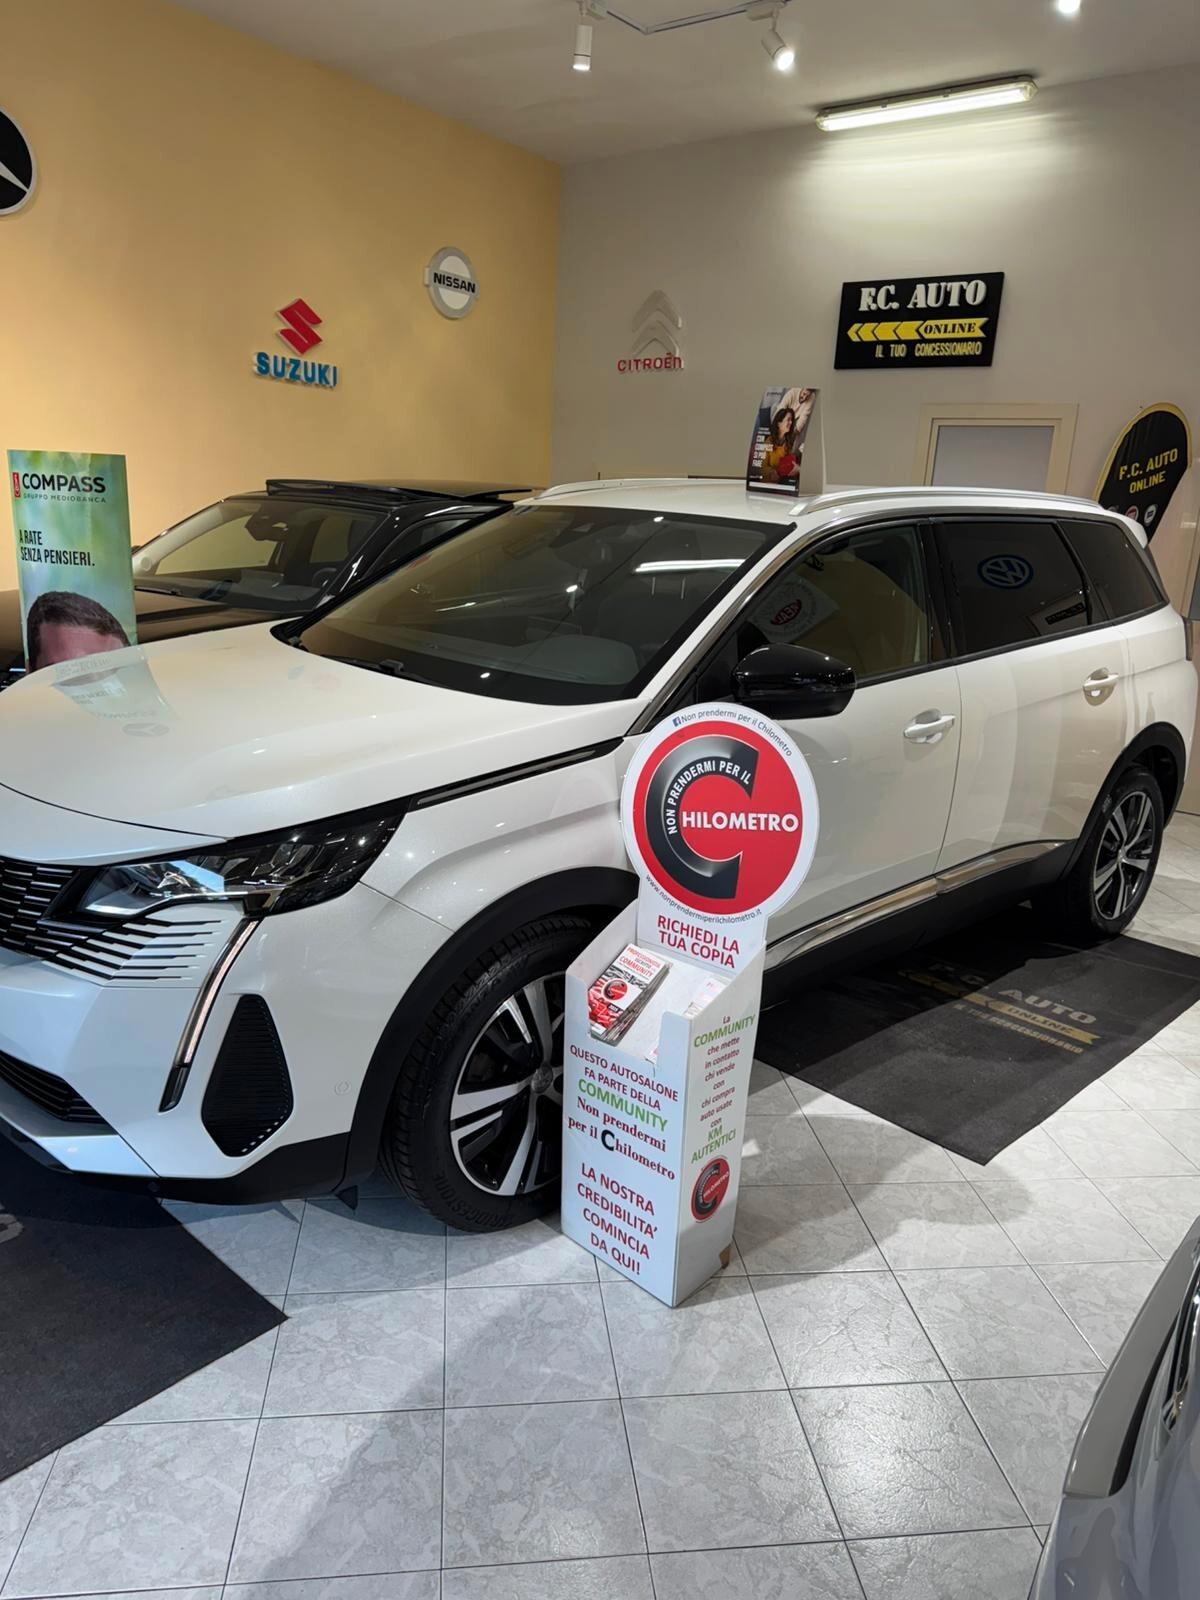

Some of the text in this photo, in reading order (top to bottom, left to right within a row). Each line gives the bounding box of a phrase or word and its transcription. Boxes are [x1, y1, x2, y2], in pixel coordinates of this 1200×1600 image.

[433, 272, 476, 294] NISSAN
[906, 279, 987, 309] AUTO
[923, 322, 977, 335] ONLINE
[875, 341, 983, 358] IL TUO CONCESSIONARIO
[256, 352, 337, 387] SUZUKI
[1119, 448, 1178, 480] F.C. AUTO
[22, 473, 106, 494] COMPASS
[1129, 470, 1166, 494] ONLINE
[51, 495, 106, 503] MEDIOBANCA
[19, 529, 43, 546] A RATE
[20, 546, 96, 567] SENZA PENSIERI.
[681, 708, 792, 757] Non prendermi per il Chilometro
[666, 760, 751, 835] NON PRENDERMI PER IL
[657, 914, 740, 955] RICHIEDI LA
[659, 930, 735, 968] TUA COPIA
[619, 955, 653, 977] COMMUNITY
[723, 1015, 731, 1024] La
[998, 989, 1097, 1024] AUTO
[1006, 1006, 1076, 1034] ONLINE
[694, 1014, 756, 1048] COMMUNITY
[704, 1049, 740, 1069] in contatto
[707, 1037, 740, 1055] che mette
[570, 1044, 679, 1102] QUESTO AUTOSALONE
[705, 1062, 735, 1081] chi vende
[713, 1080, 725, 1090] con
[584, 1067, 661, 1111] FA PARTE DELLA
[701, 1086, 735, 1108] chi compra
[578, 1078, 668, 1132] COMMUNITY
[700, 1099, 733, 1122] auto usate
[577, 1096, 666, 1152] Non prendermi
[708, 1125, 723, 1142] KM
[710, 1118, 722, 1128] con
[568, 1117, 675, 1180] per il Chilometro
[691, 1128, 737, 1164] AUTENTICI
[581, 1162, 655, 1217] LA NOSTRA
[577, 1182, 658, 1239] CREDIBILITA'
[583, 1207, 650, 1260] COMINCIA
[591, 1232, 640, 1276] DA QUI!
